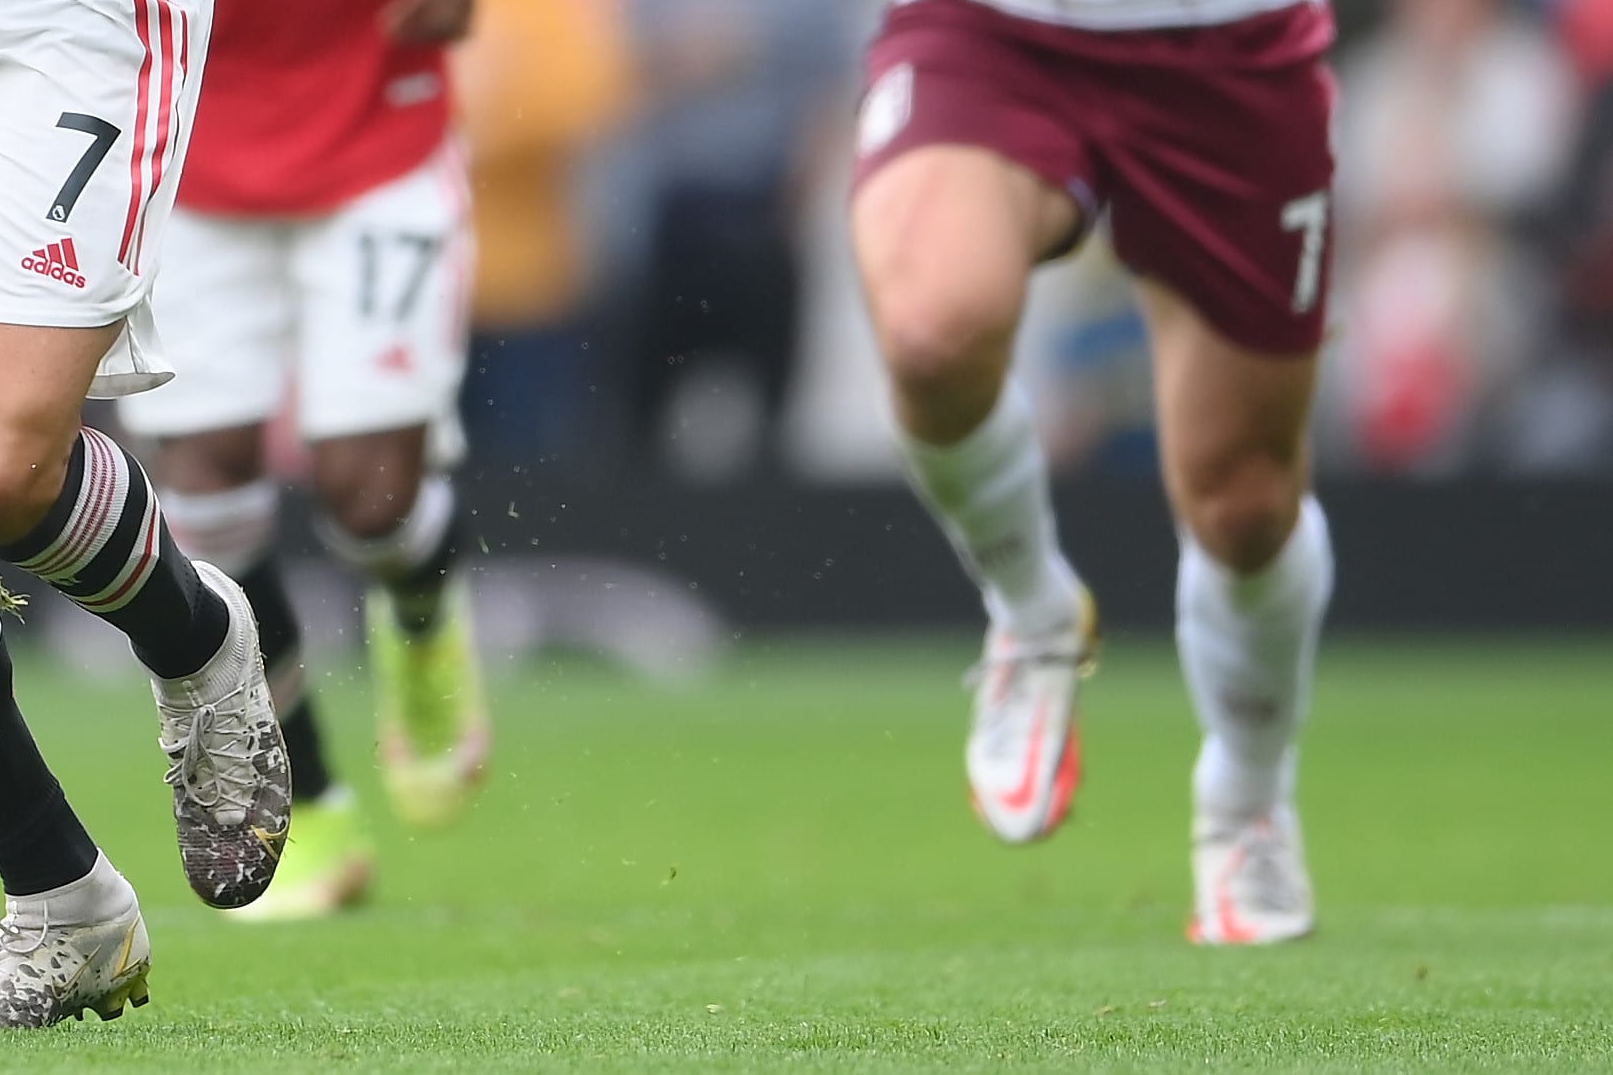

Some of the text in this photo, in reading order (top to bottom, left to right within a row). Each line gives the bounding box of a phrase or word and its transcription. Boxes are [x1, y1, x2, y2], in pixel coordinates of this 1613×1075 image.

[46, 111, 122, 223] 7
[21, 256, 86, 289] adidas
[357, 231, 445, 323] 17
[1281, 191, 1328, 314] 7
